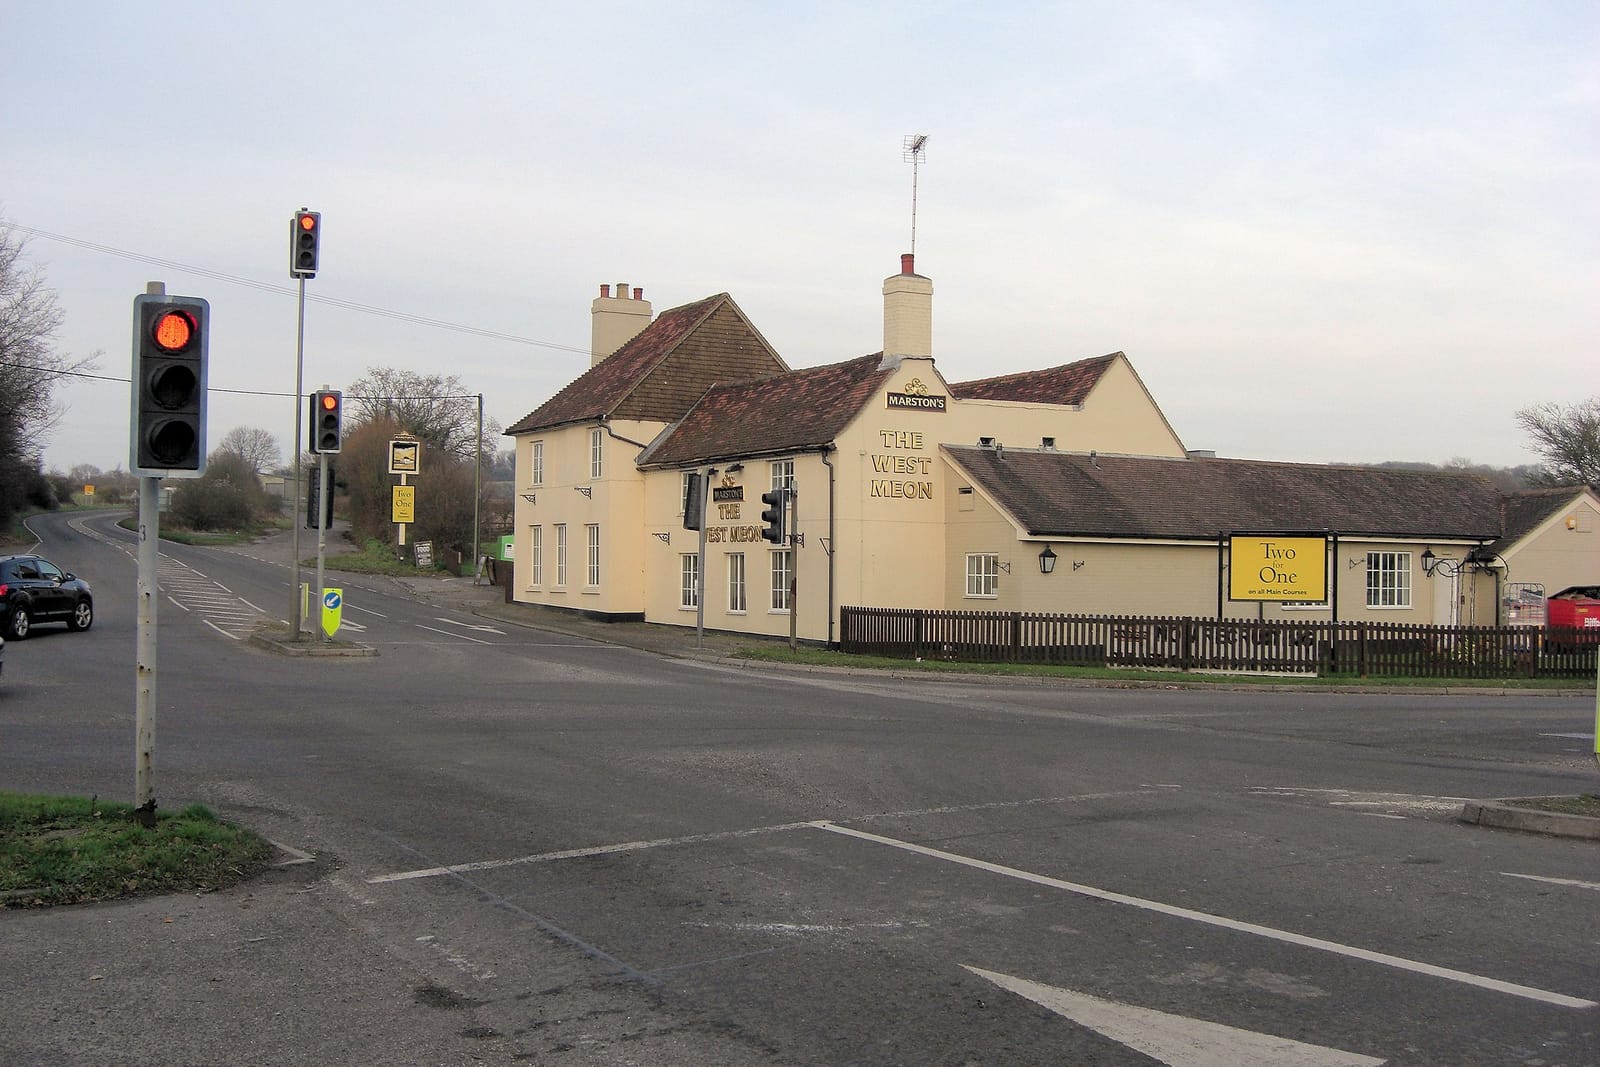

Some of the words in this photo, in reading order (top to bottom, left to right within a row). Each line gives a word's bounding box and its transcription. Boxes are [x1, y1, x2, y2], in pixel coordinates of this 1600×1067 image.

[889, 396, 945, 408] MARSTON'S
[880, 430, 923, 449] THE
[872, 455, 932, 474] WEST
[871, 480, 933, 499] MEON
[718, 503, 741, 520] THE
[705, 526, 728, 543] EST
[730, 525, 763, 542] MEON
[1260, 543, 1296, 559] Two
[1272, 560, 1284, 569] for
[1259, 566, 1297, 583] One
